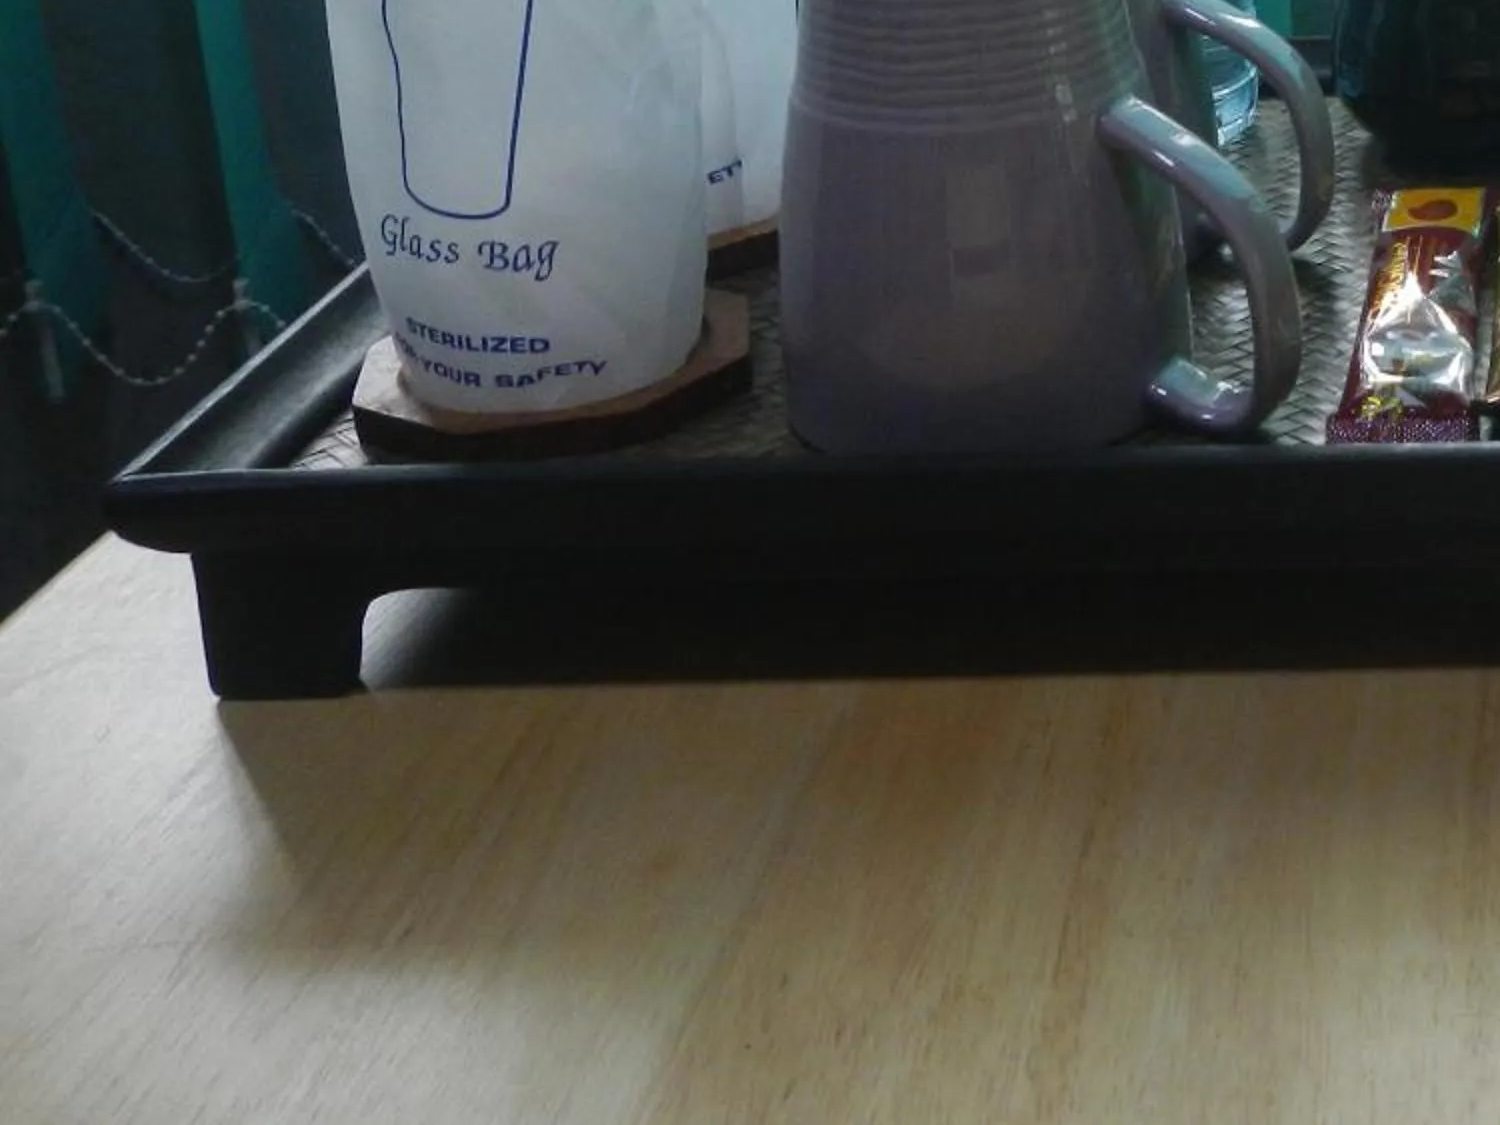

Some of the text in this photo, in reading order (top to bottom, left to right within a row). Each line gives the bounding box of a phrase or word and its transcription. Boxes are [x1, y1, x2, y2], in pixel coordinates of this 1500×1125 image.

[380, 212, 560, 281] Glass Bag
[405, 316, 551, 354] STERILIZED
[421, 358, 482, 388] YOUR
[493, 360, 608, 388] SAFETY
